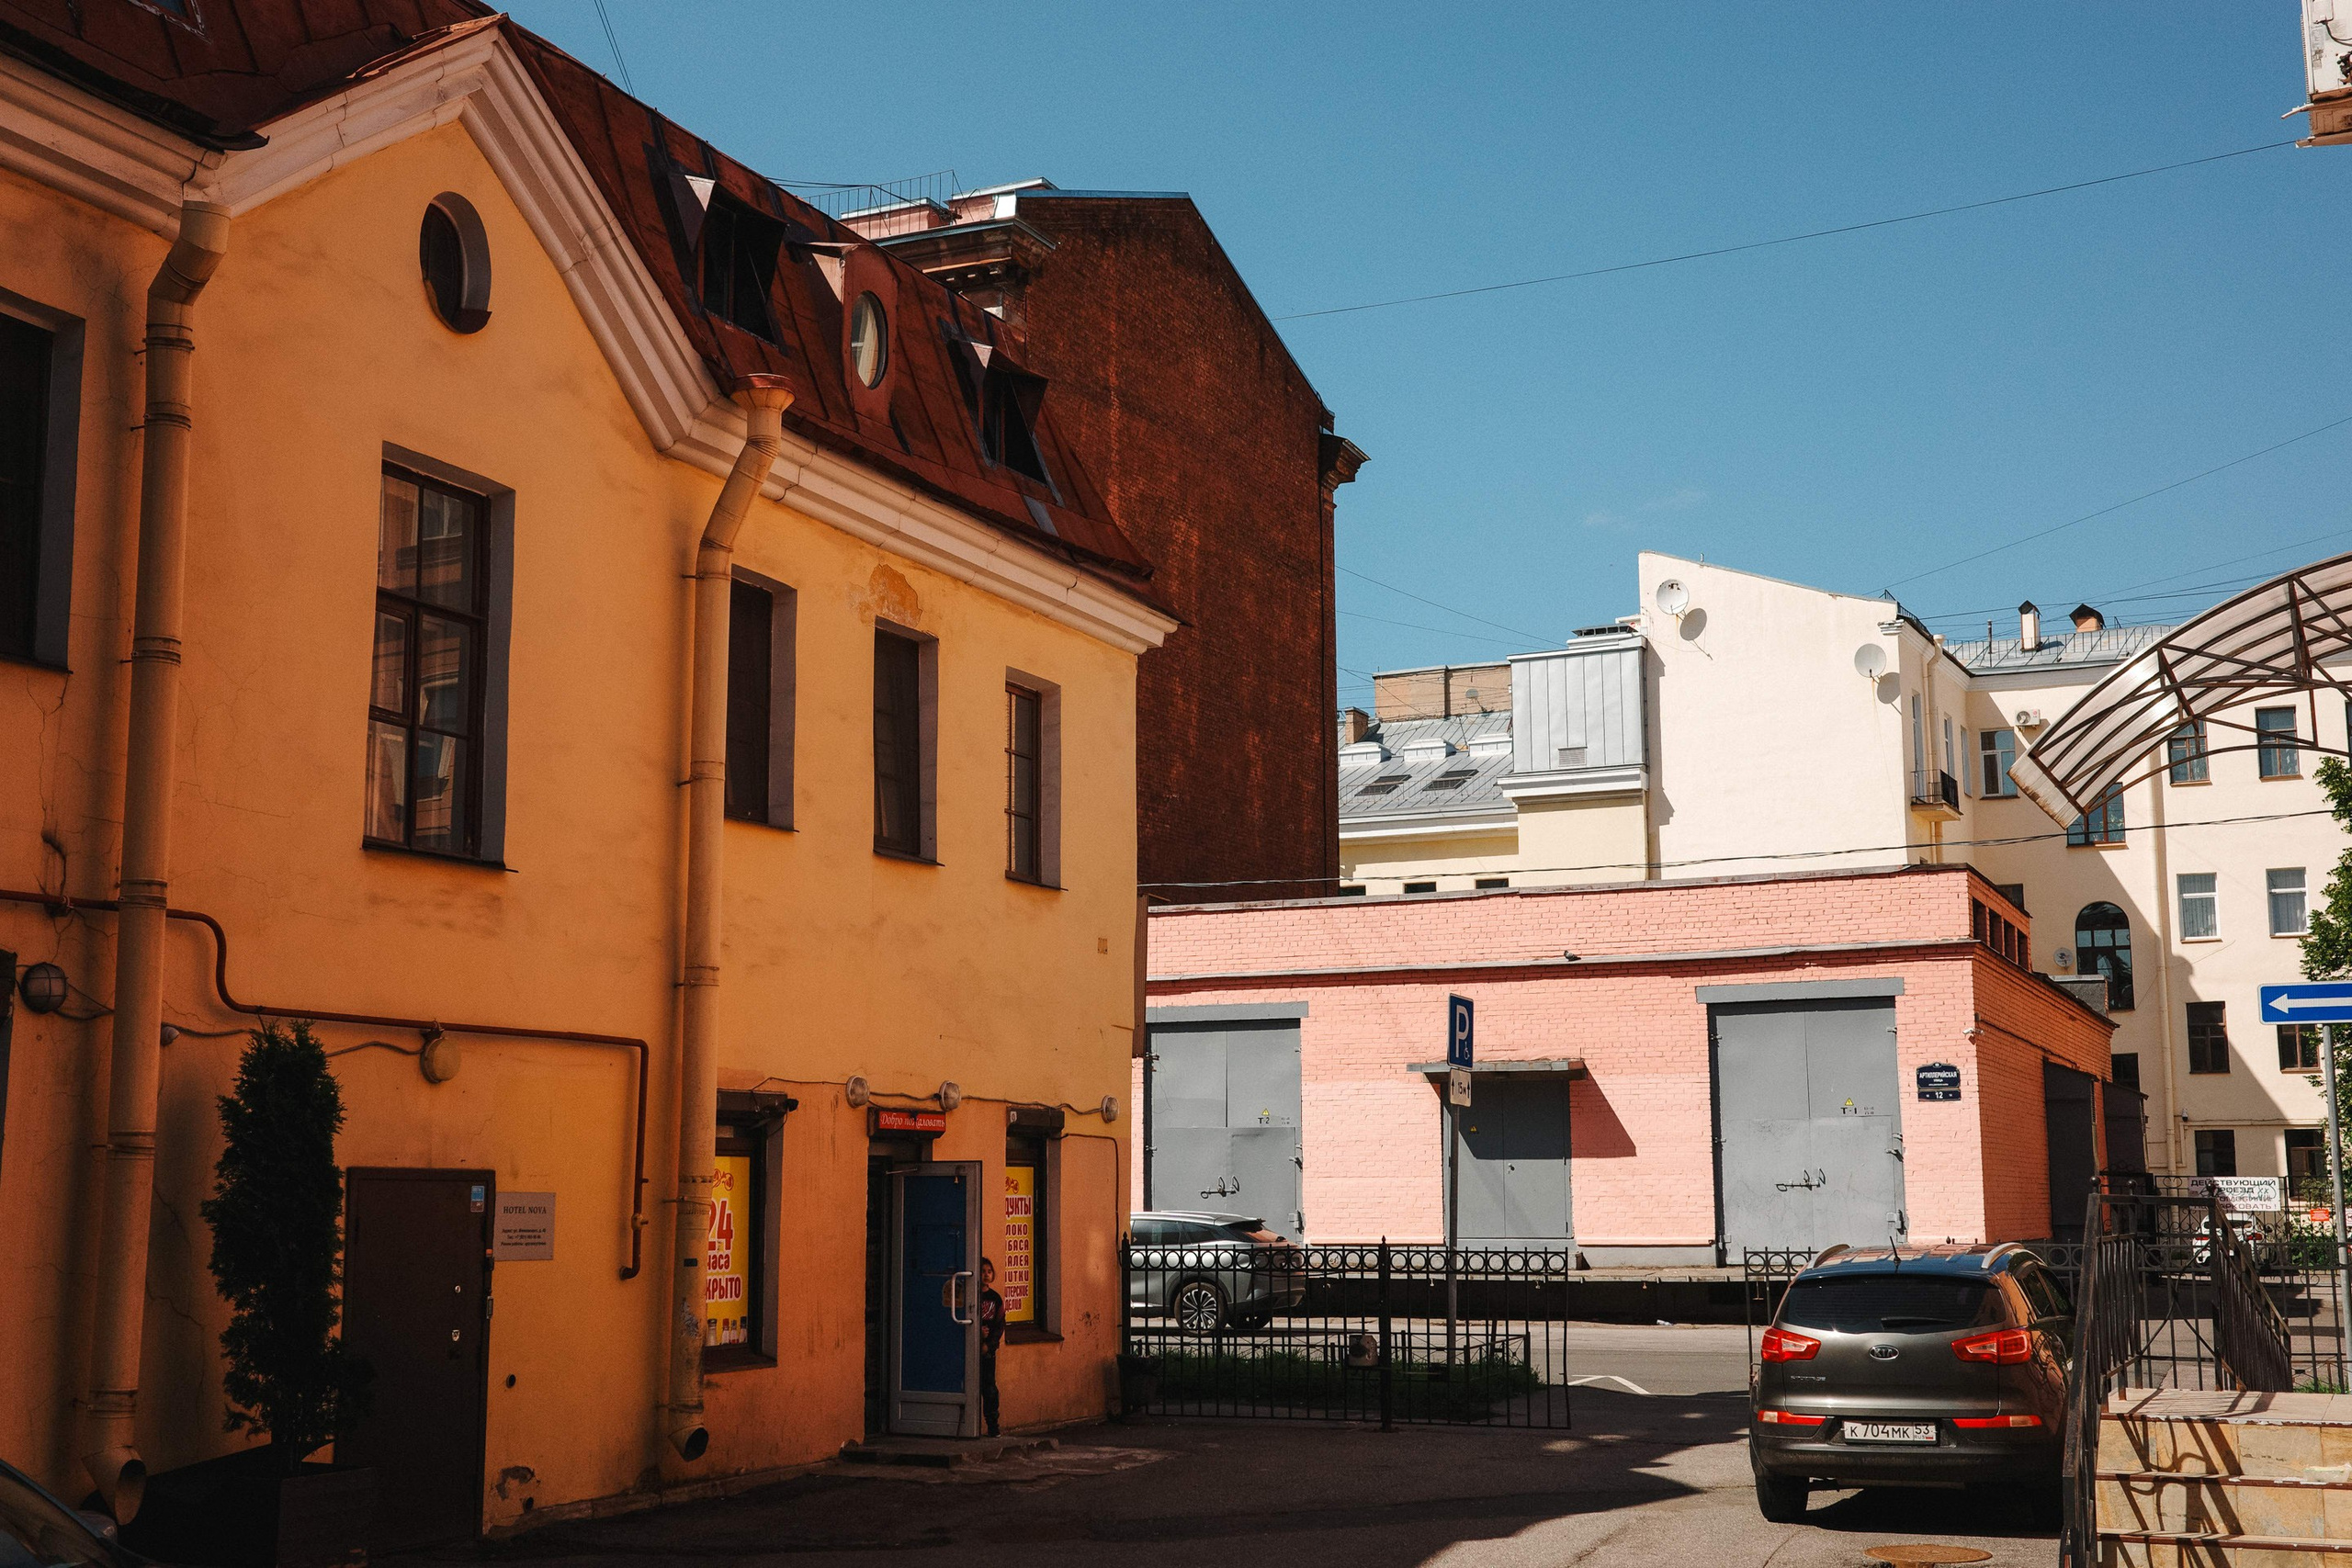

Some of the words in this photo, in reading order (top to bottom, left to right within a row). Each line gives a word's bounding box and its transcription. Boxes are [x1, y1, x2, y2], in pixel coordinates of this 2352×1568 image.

[1456, 1005, 1469, 1058] P
[881, 1112, 903, 1129] Добро
[1005, 1197, 1031, 1218] ДУКТЫ
[708, 1200, 734, 1251] 24
[1005, 1224, 1028, 1236] ЛОКО
[1005, 1239, 1029, 1251] БАСА
[1005, 1255, 1029, 1267] АЛЕЯ
[706, 1276, 741, 1301] КРЫТО
[1004, 1298, 1022, 1312] ДЕЛИЯ
[1873, 1347, 1894, 1359] KIA
[1915, 1424, 1929, 1435] 53
